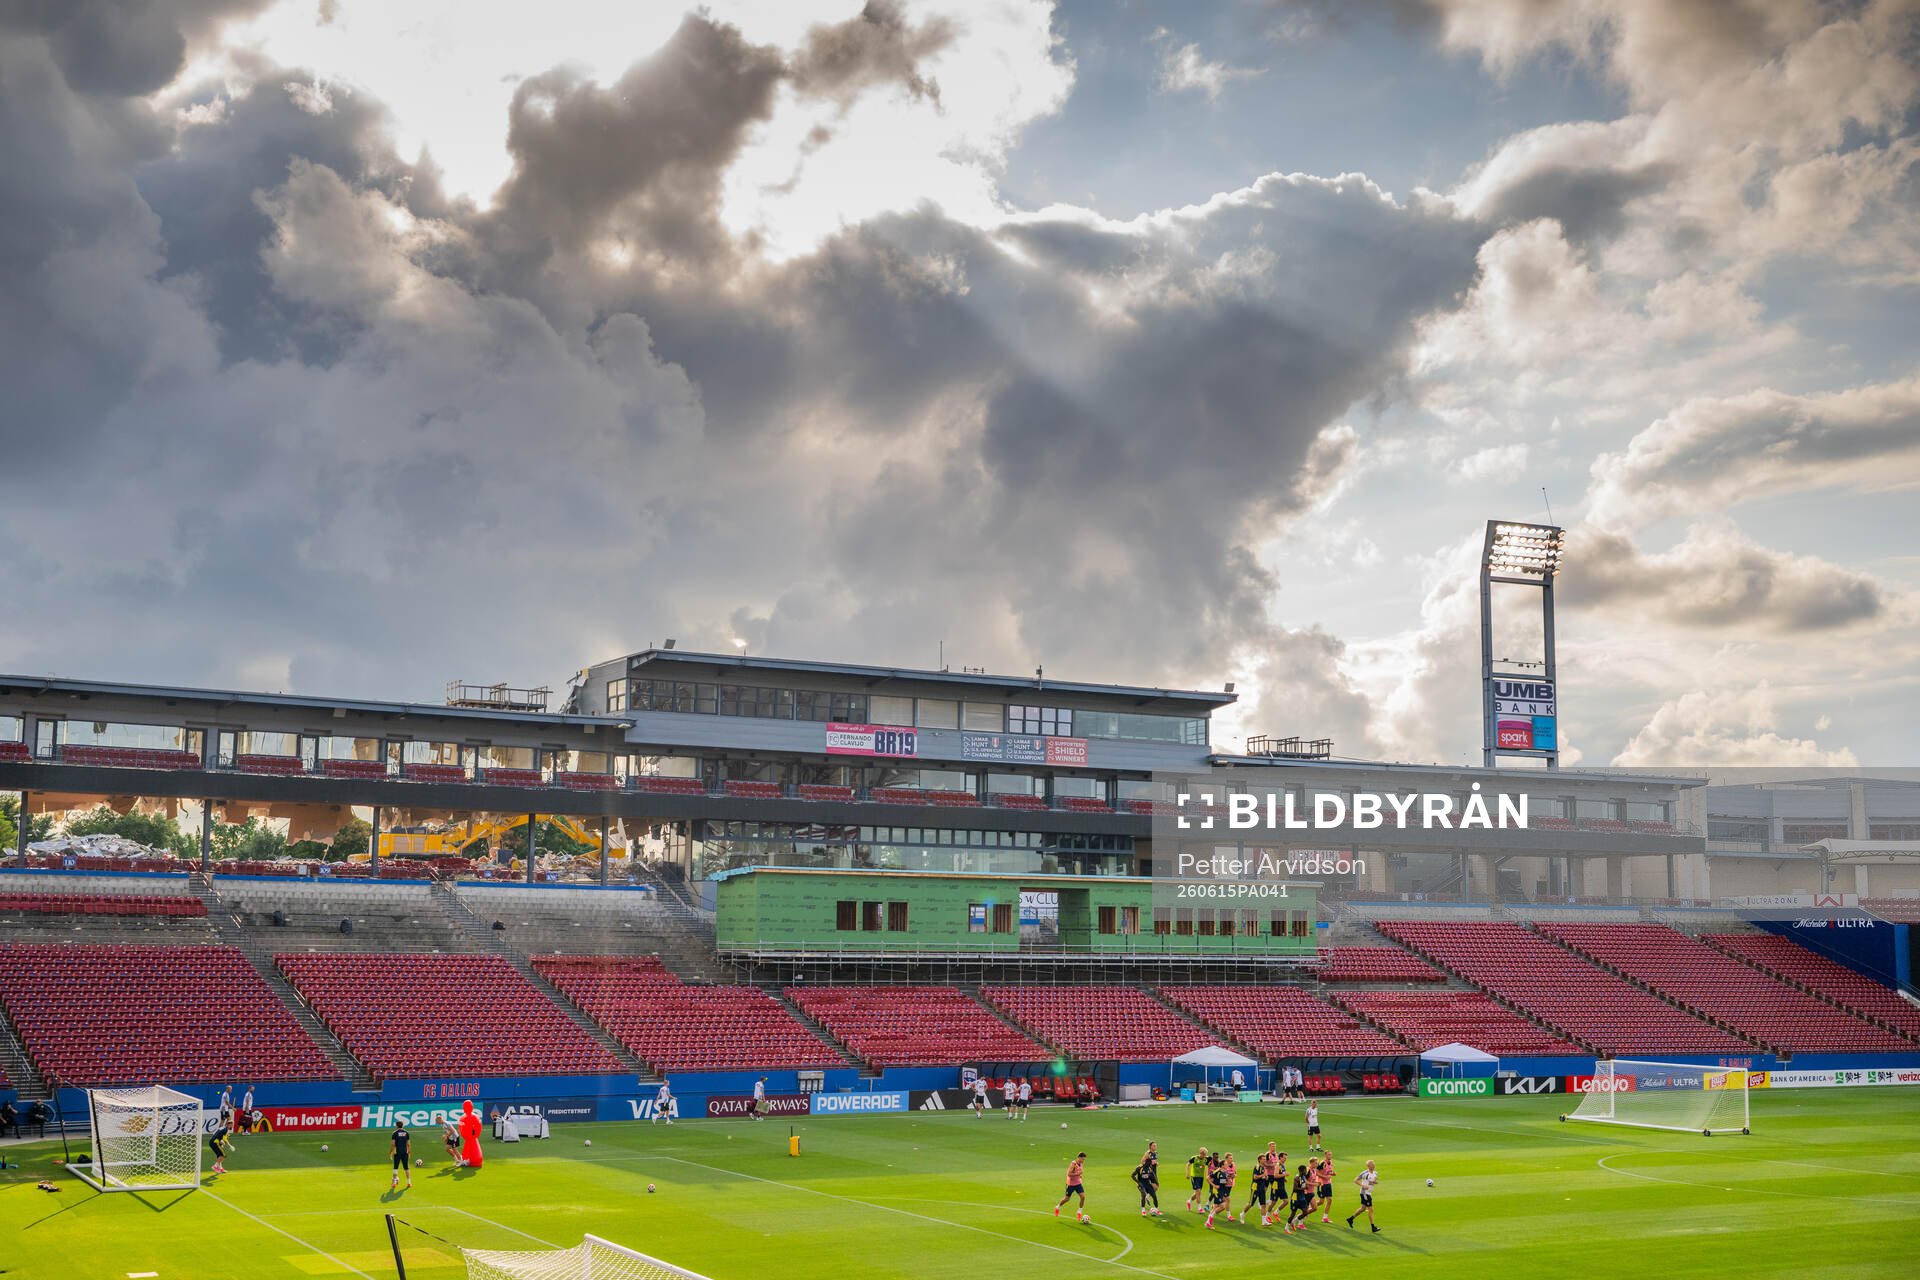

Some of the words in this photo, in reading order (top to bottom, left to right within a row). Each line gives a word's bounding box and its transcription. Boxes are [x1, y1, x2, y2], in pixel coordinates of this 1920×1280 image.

[1495, 682, 1554, 699] UMB
[1495, 702, 1554, 715] BANK
[839, 734, 872, 742] FERNANDO
[874, 731, 915, 756] BR19
[1501, 731, 1528, 744] spark
[1055, 747, 1086, 756] SHIELD
[1055, 755, 1086, 763] WINNERS
[1837, 917, 1875, 928] ULTRA
[1427, 1080, 1487, 1095] aramco
[1573, 1076, 1629, 1093] Lenovo
[1673, 1078, 1699, 1087] ULTRA
[423, 1084, 437, 1098] FC
[440, 1083, 480, 1098] DALLAS
[817, 1094, 902, 1111] POWERADE
[547, 1107, 591, 1116] PREDICTSTREET
[276, 1113, 298, 1126] i'm
[301, 1112, 340, 1126] lovin'
